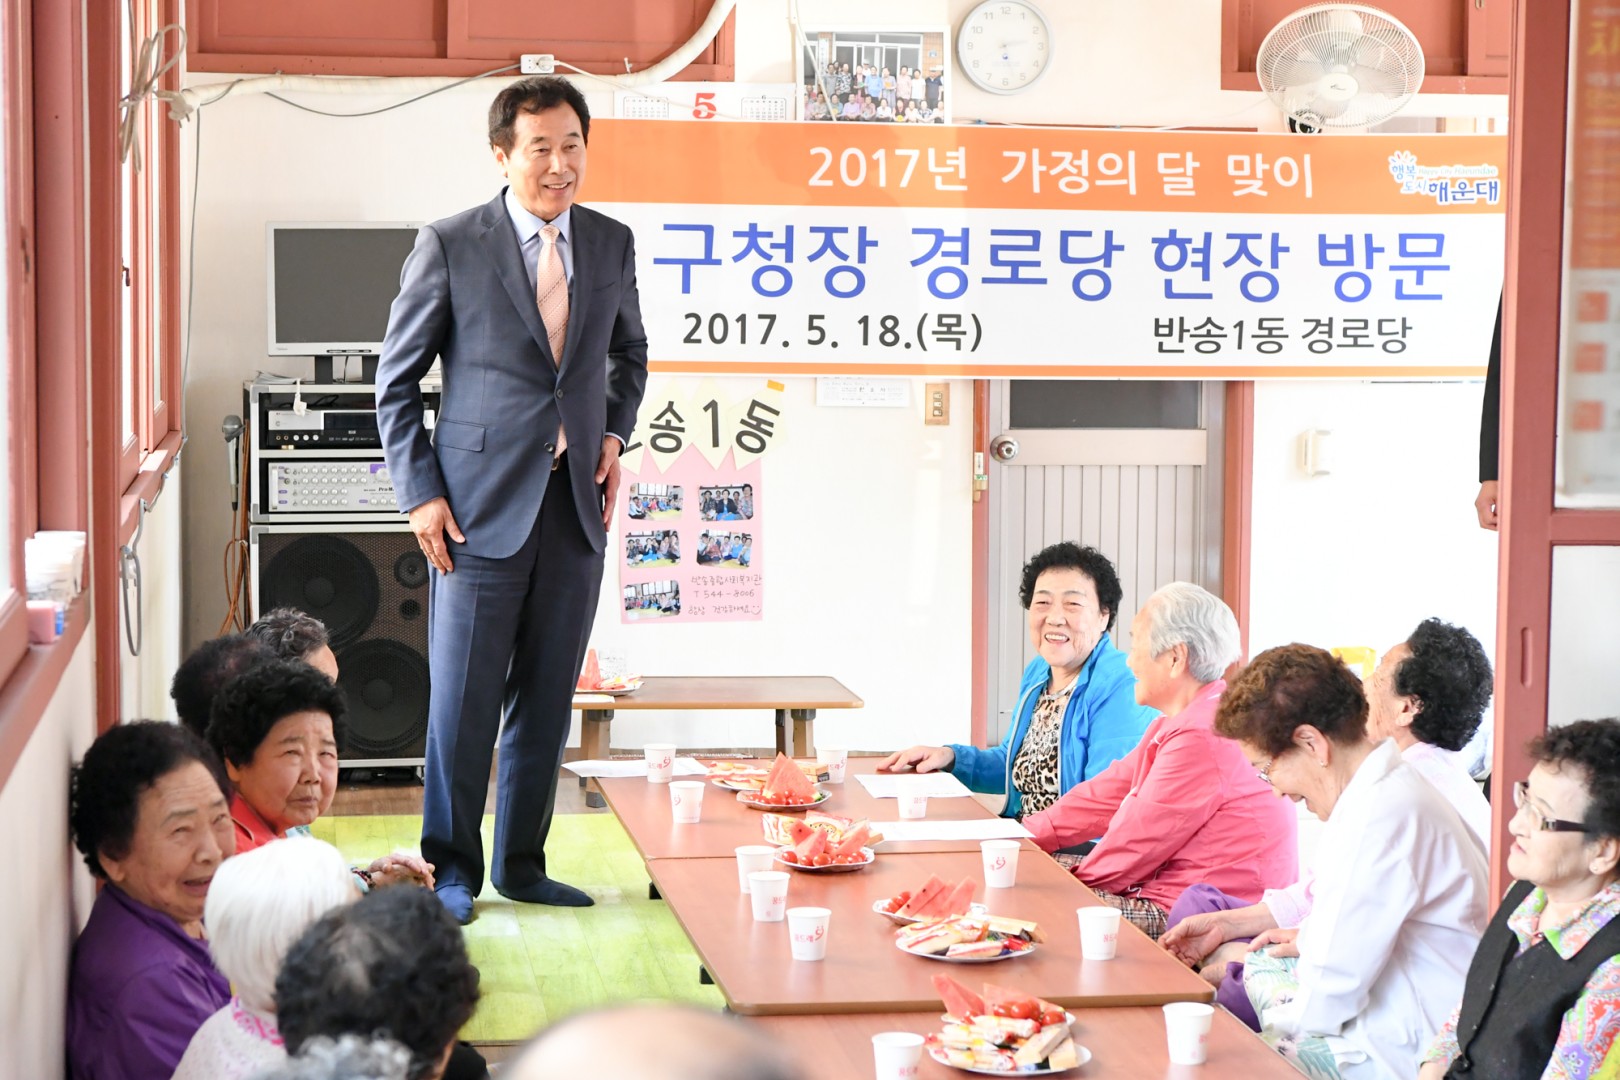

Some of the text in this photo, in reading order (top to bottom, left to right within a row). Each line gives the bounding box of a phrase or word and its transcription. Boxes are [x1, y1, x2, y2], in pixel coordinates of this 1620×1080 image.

[971, 26, 983, 34] 10
[1032, 26, 1039, 34] 2
[967, 42, 974, 50] 9
[1038, 42, 1044, 50] 3
[1002, 78, 1008, 86] 6
[1020, 73, 1026, 81] 5
[692, 92, 717, 119] 5
[808, 146, 1313, 198] 2017년 가정의 달 맞이
[1391, 164, 1416, 180] 행복
[1403, 180, 1427, 192] 도시
[1428, 180, 1498, 202] 해운대
[653, 222, 1451, 303] 구청장 경로당 현장 방문
[683, 312, 983, 352] 2017. 5. 18.(목)
[1154, 316, 1413, 354] 반송1동 경로당
